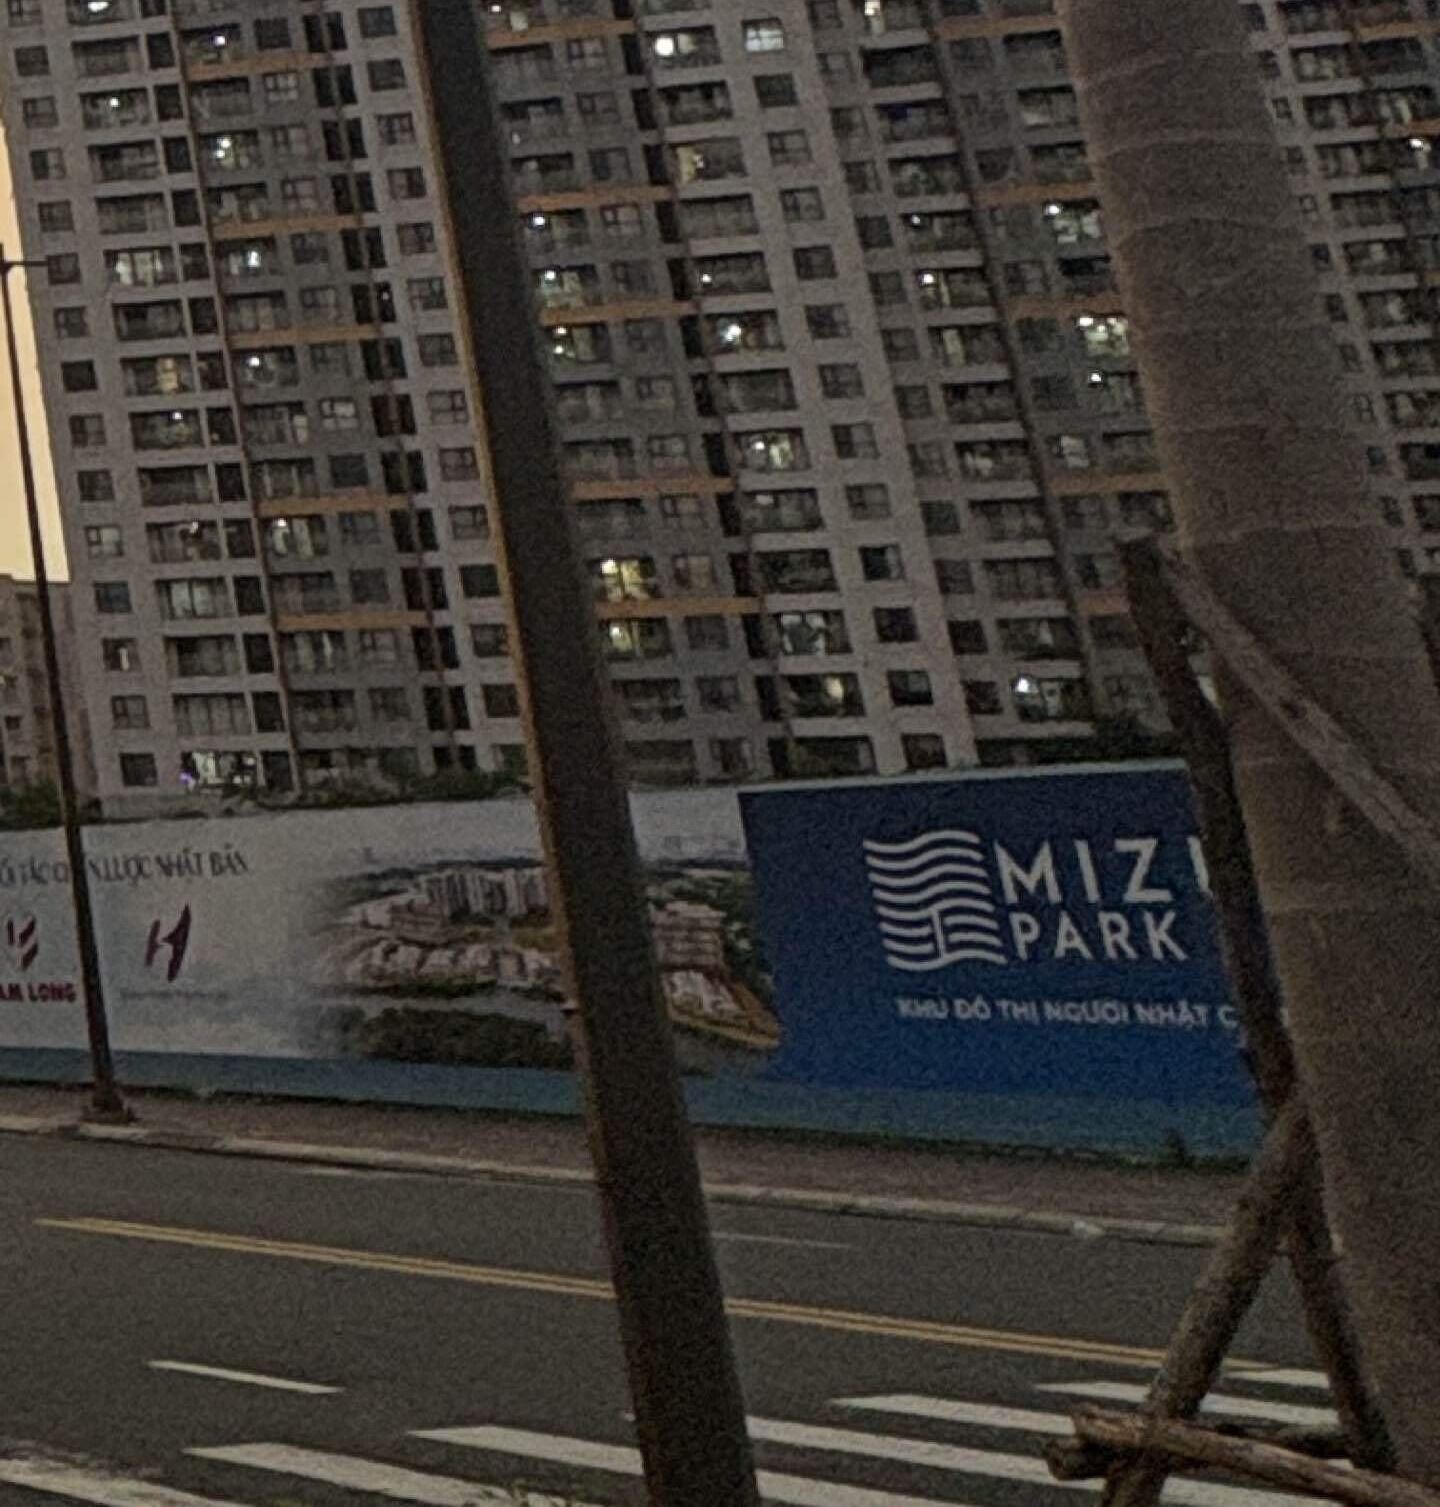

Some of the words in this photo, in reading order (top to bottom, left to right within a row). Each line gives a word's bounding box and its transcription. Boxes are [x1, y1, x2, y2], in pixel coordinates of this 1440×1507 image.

[1008, 910, 1189, 962] PARK
[27, 982, 77, 1003] LONG
[897, 997, 948, 1020] KHU
